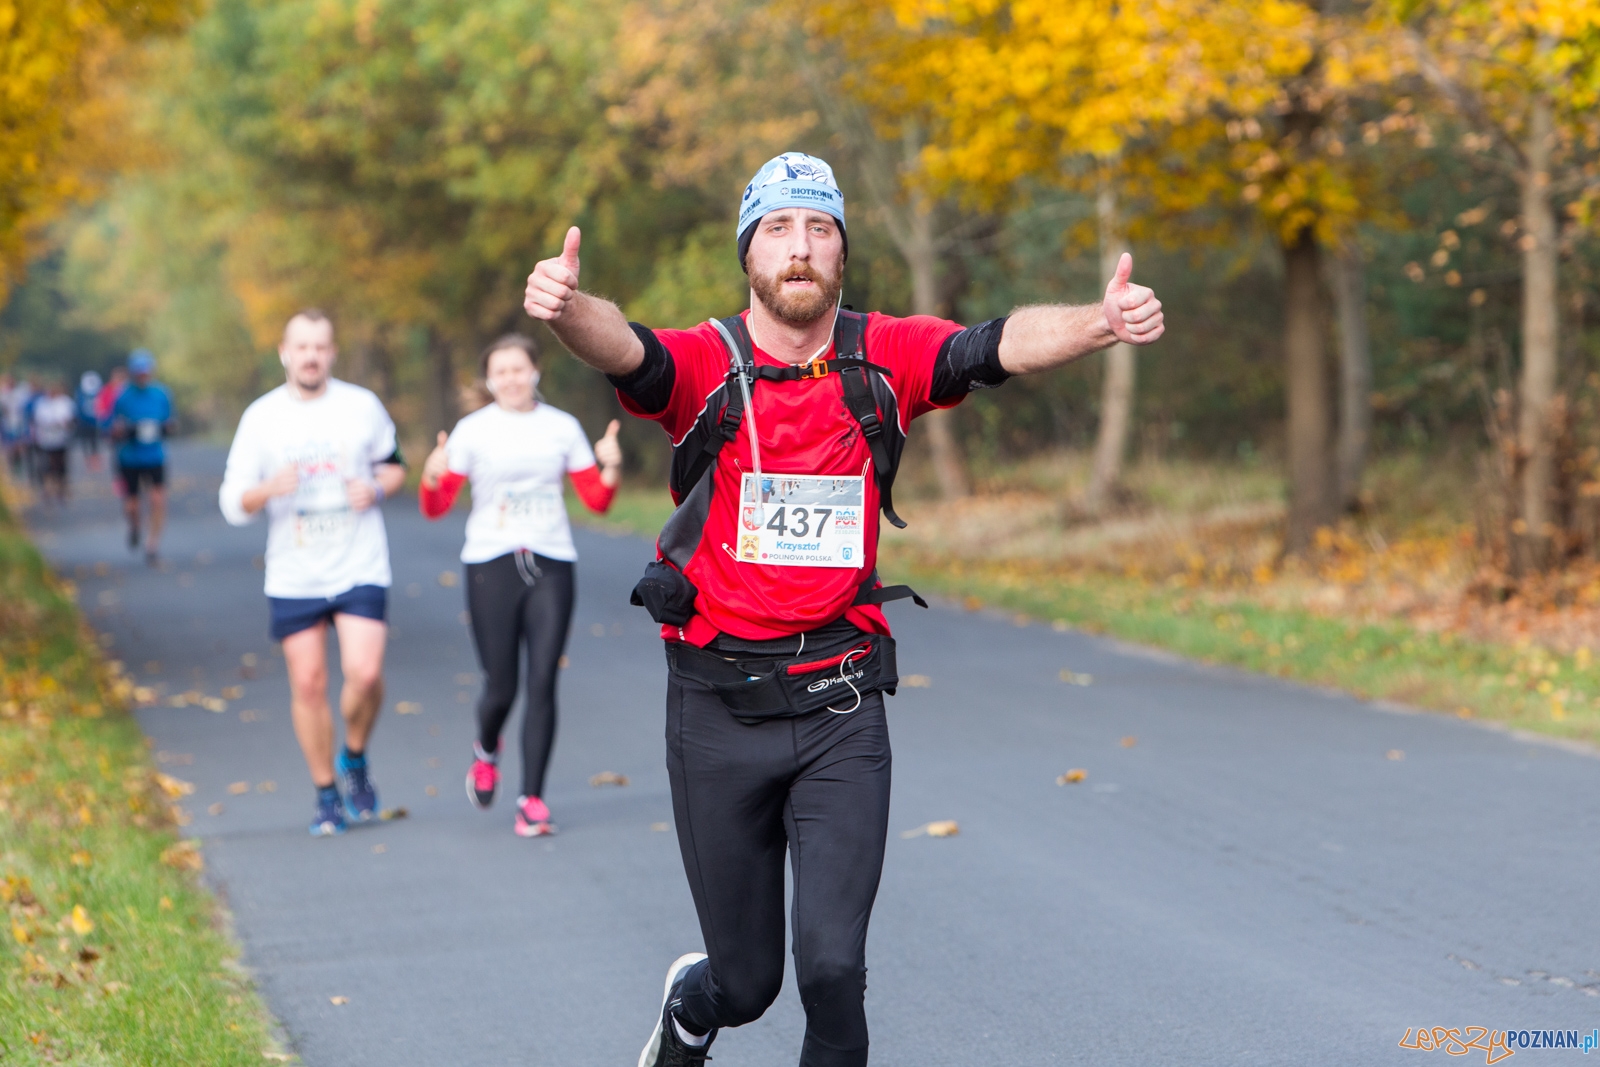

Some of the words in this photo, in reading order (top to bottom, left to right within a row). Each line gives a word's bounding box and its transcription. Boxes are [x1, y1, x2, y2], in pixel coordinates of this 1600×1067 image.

[791, 188, 833, 200] BIOTRONIK
[767, 506, 832, 537] 437
[776, 541, 820, 552] Krzysztof
